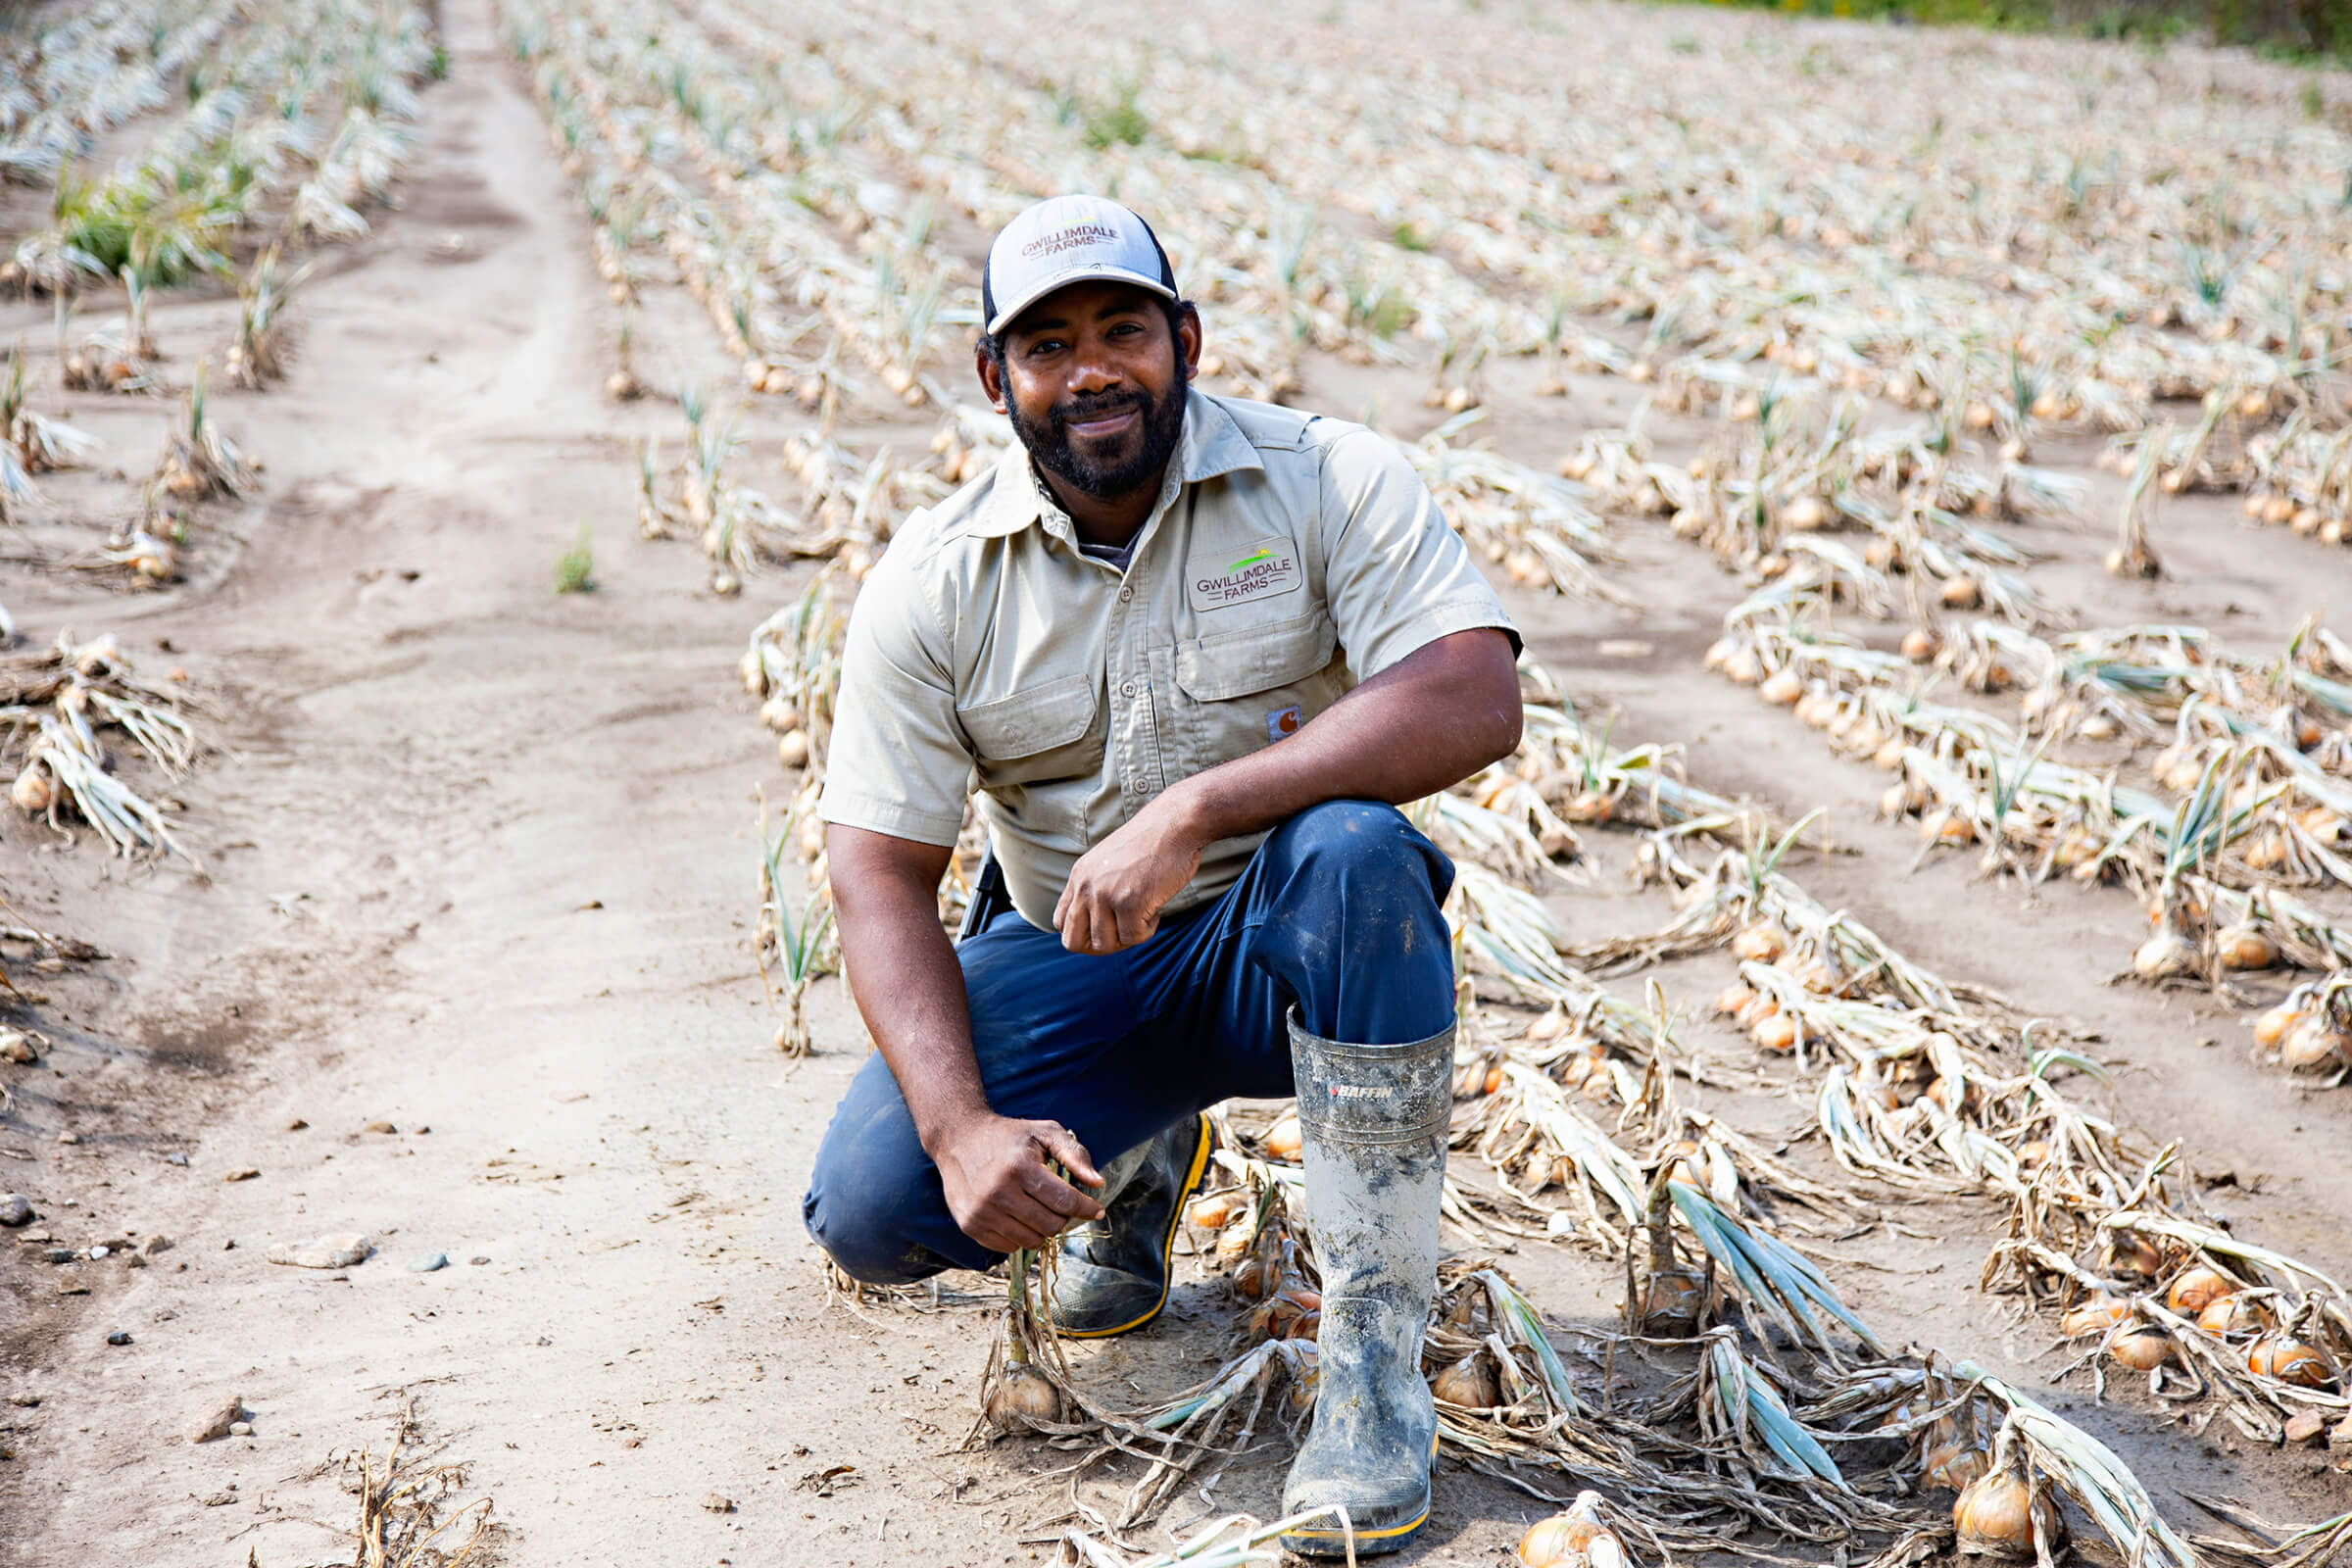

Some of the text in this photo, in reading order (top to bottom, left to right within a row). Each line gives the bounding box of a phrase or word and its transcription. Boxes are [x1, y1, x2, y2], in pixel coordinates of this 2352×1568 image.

[1022, 224, 1118, 256] GWILLIMDALE
[1045, 235, 1096, 256] FARMS
[1197, 559, 1292, 592] GWILLIMDALE
[1224, 577, 1269, 600] FARMS
[1338, 1084, 1394, 1099] BAFFIN
